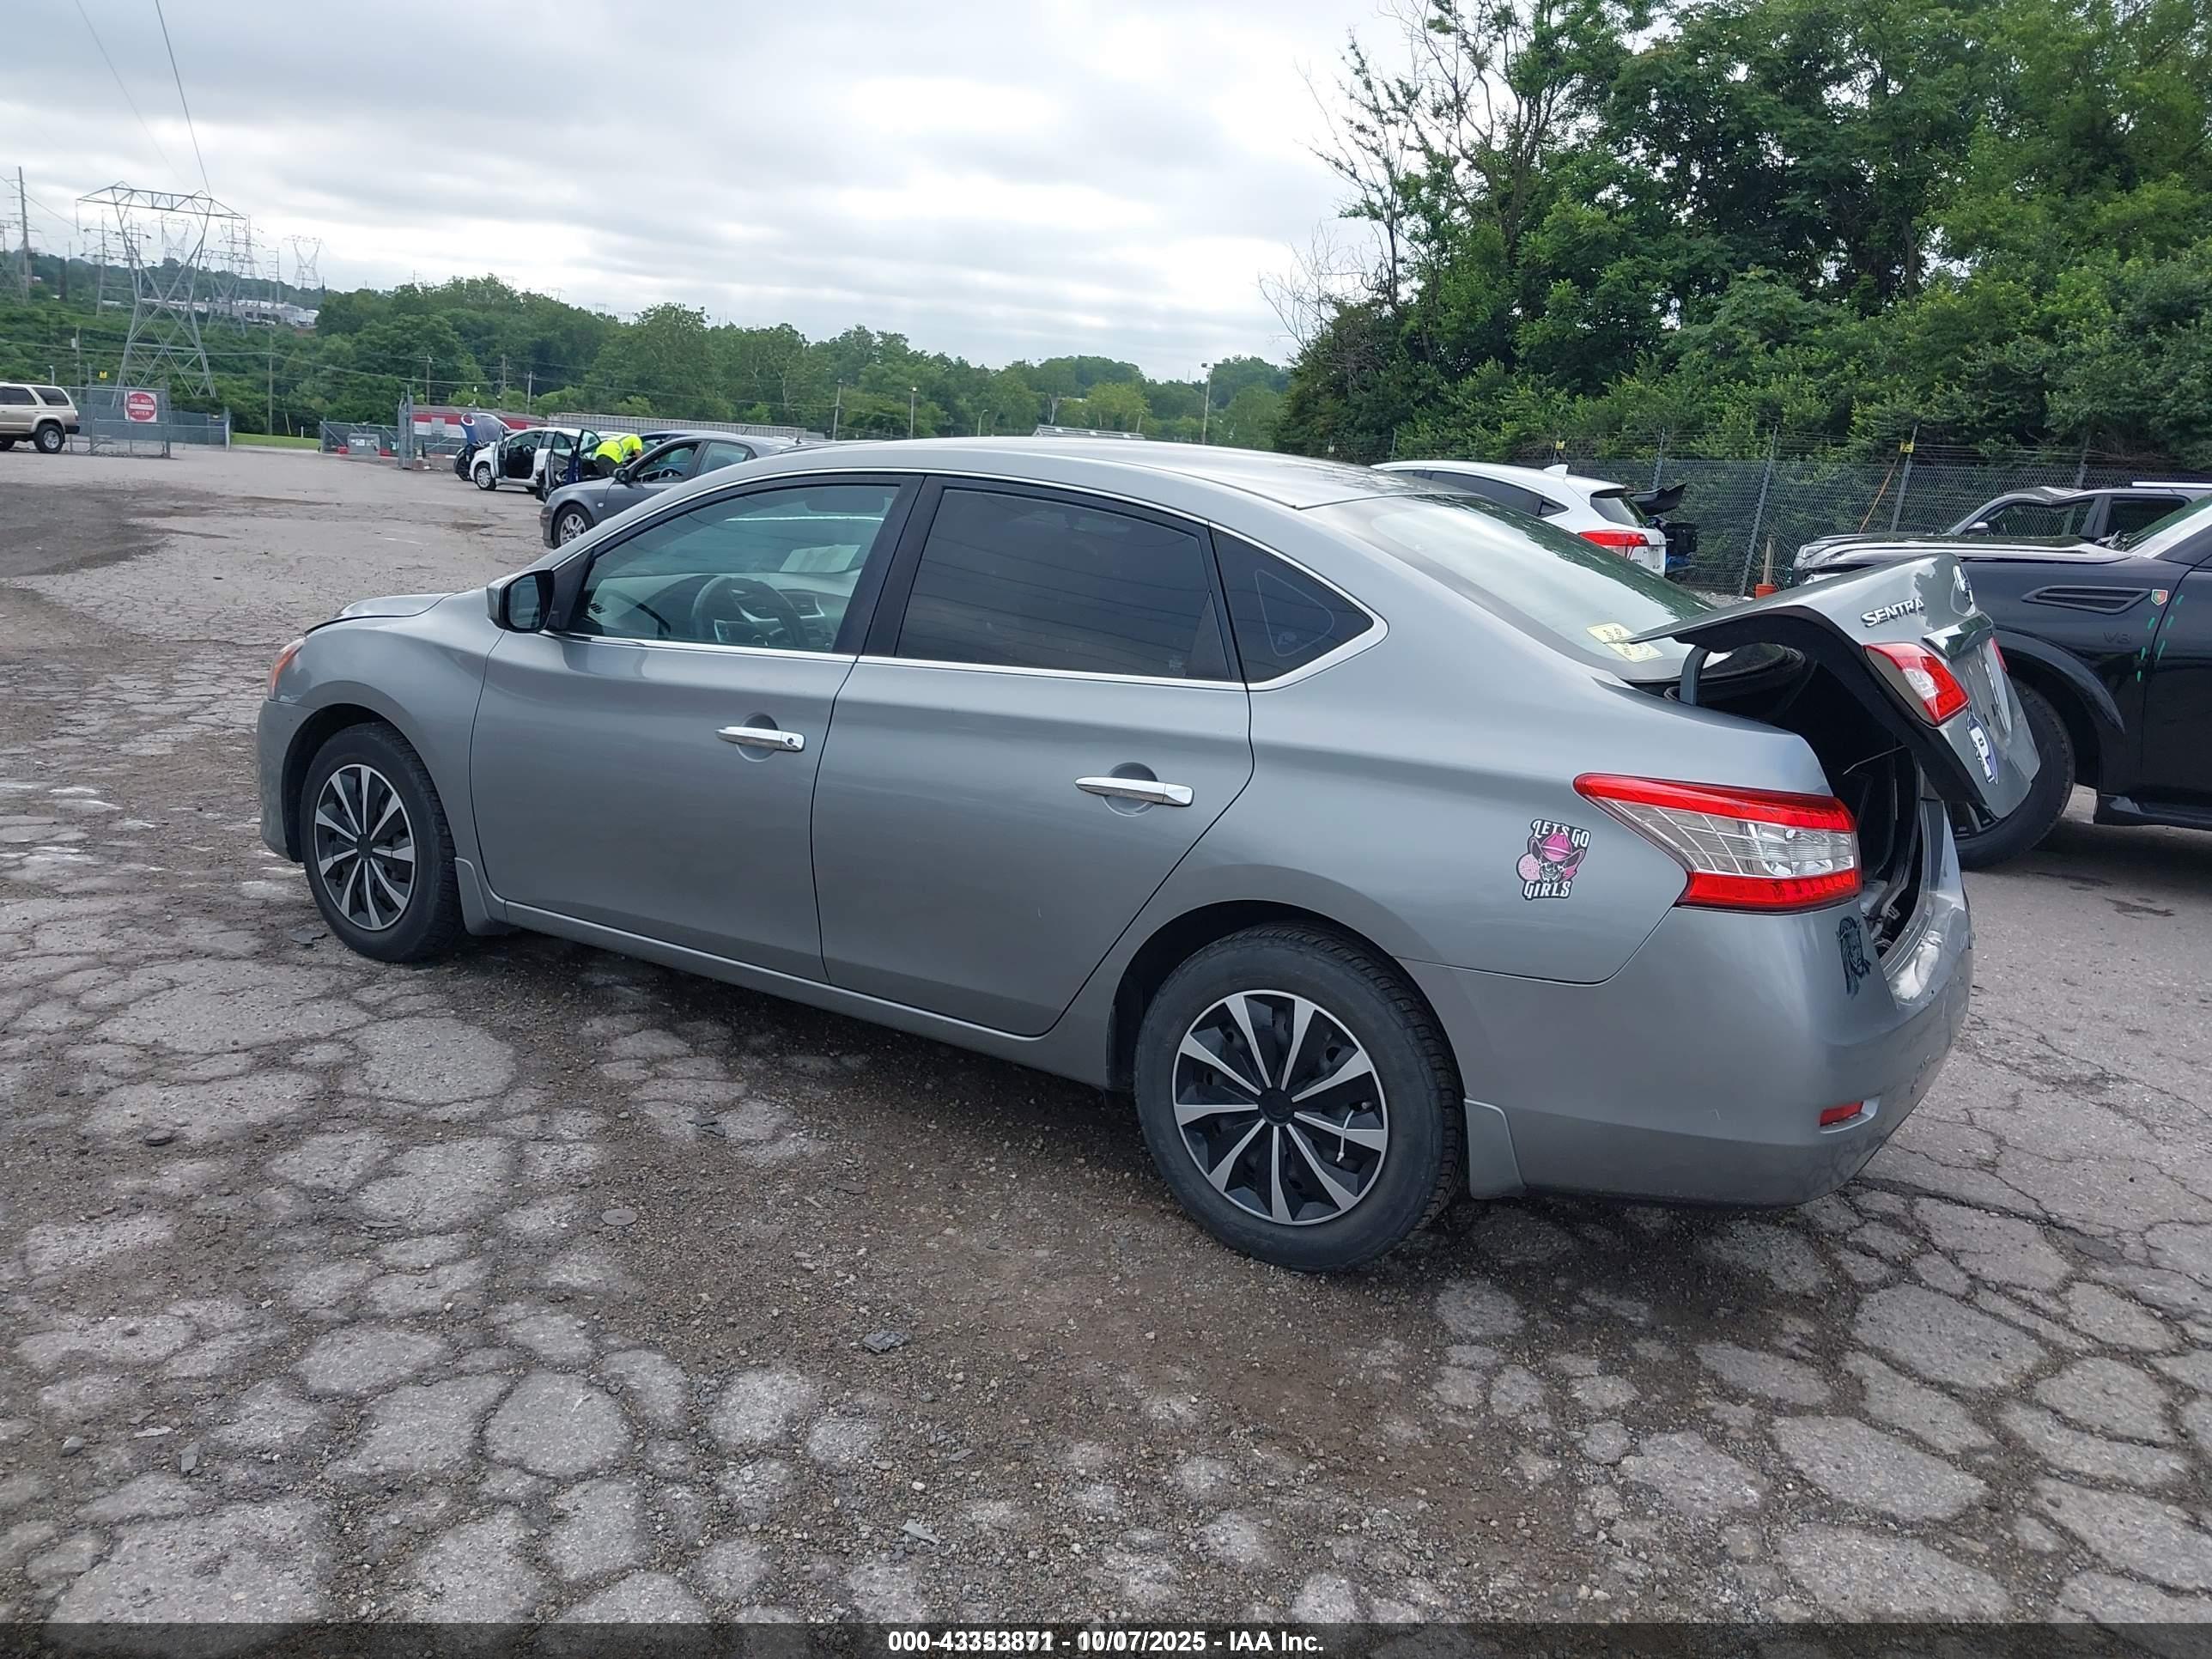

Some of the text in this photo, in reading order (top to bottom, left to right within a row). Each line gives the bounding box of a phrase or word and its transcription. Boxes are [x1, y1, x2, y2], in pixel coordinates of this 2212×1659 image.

[1861, 598, 1924, 628] SENTRA
[1571, 829, 1590, 848] GO
[1524, 880, 1571, 899] GIRLS
